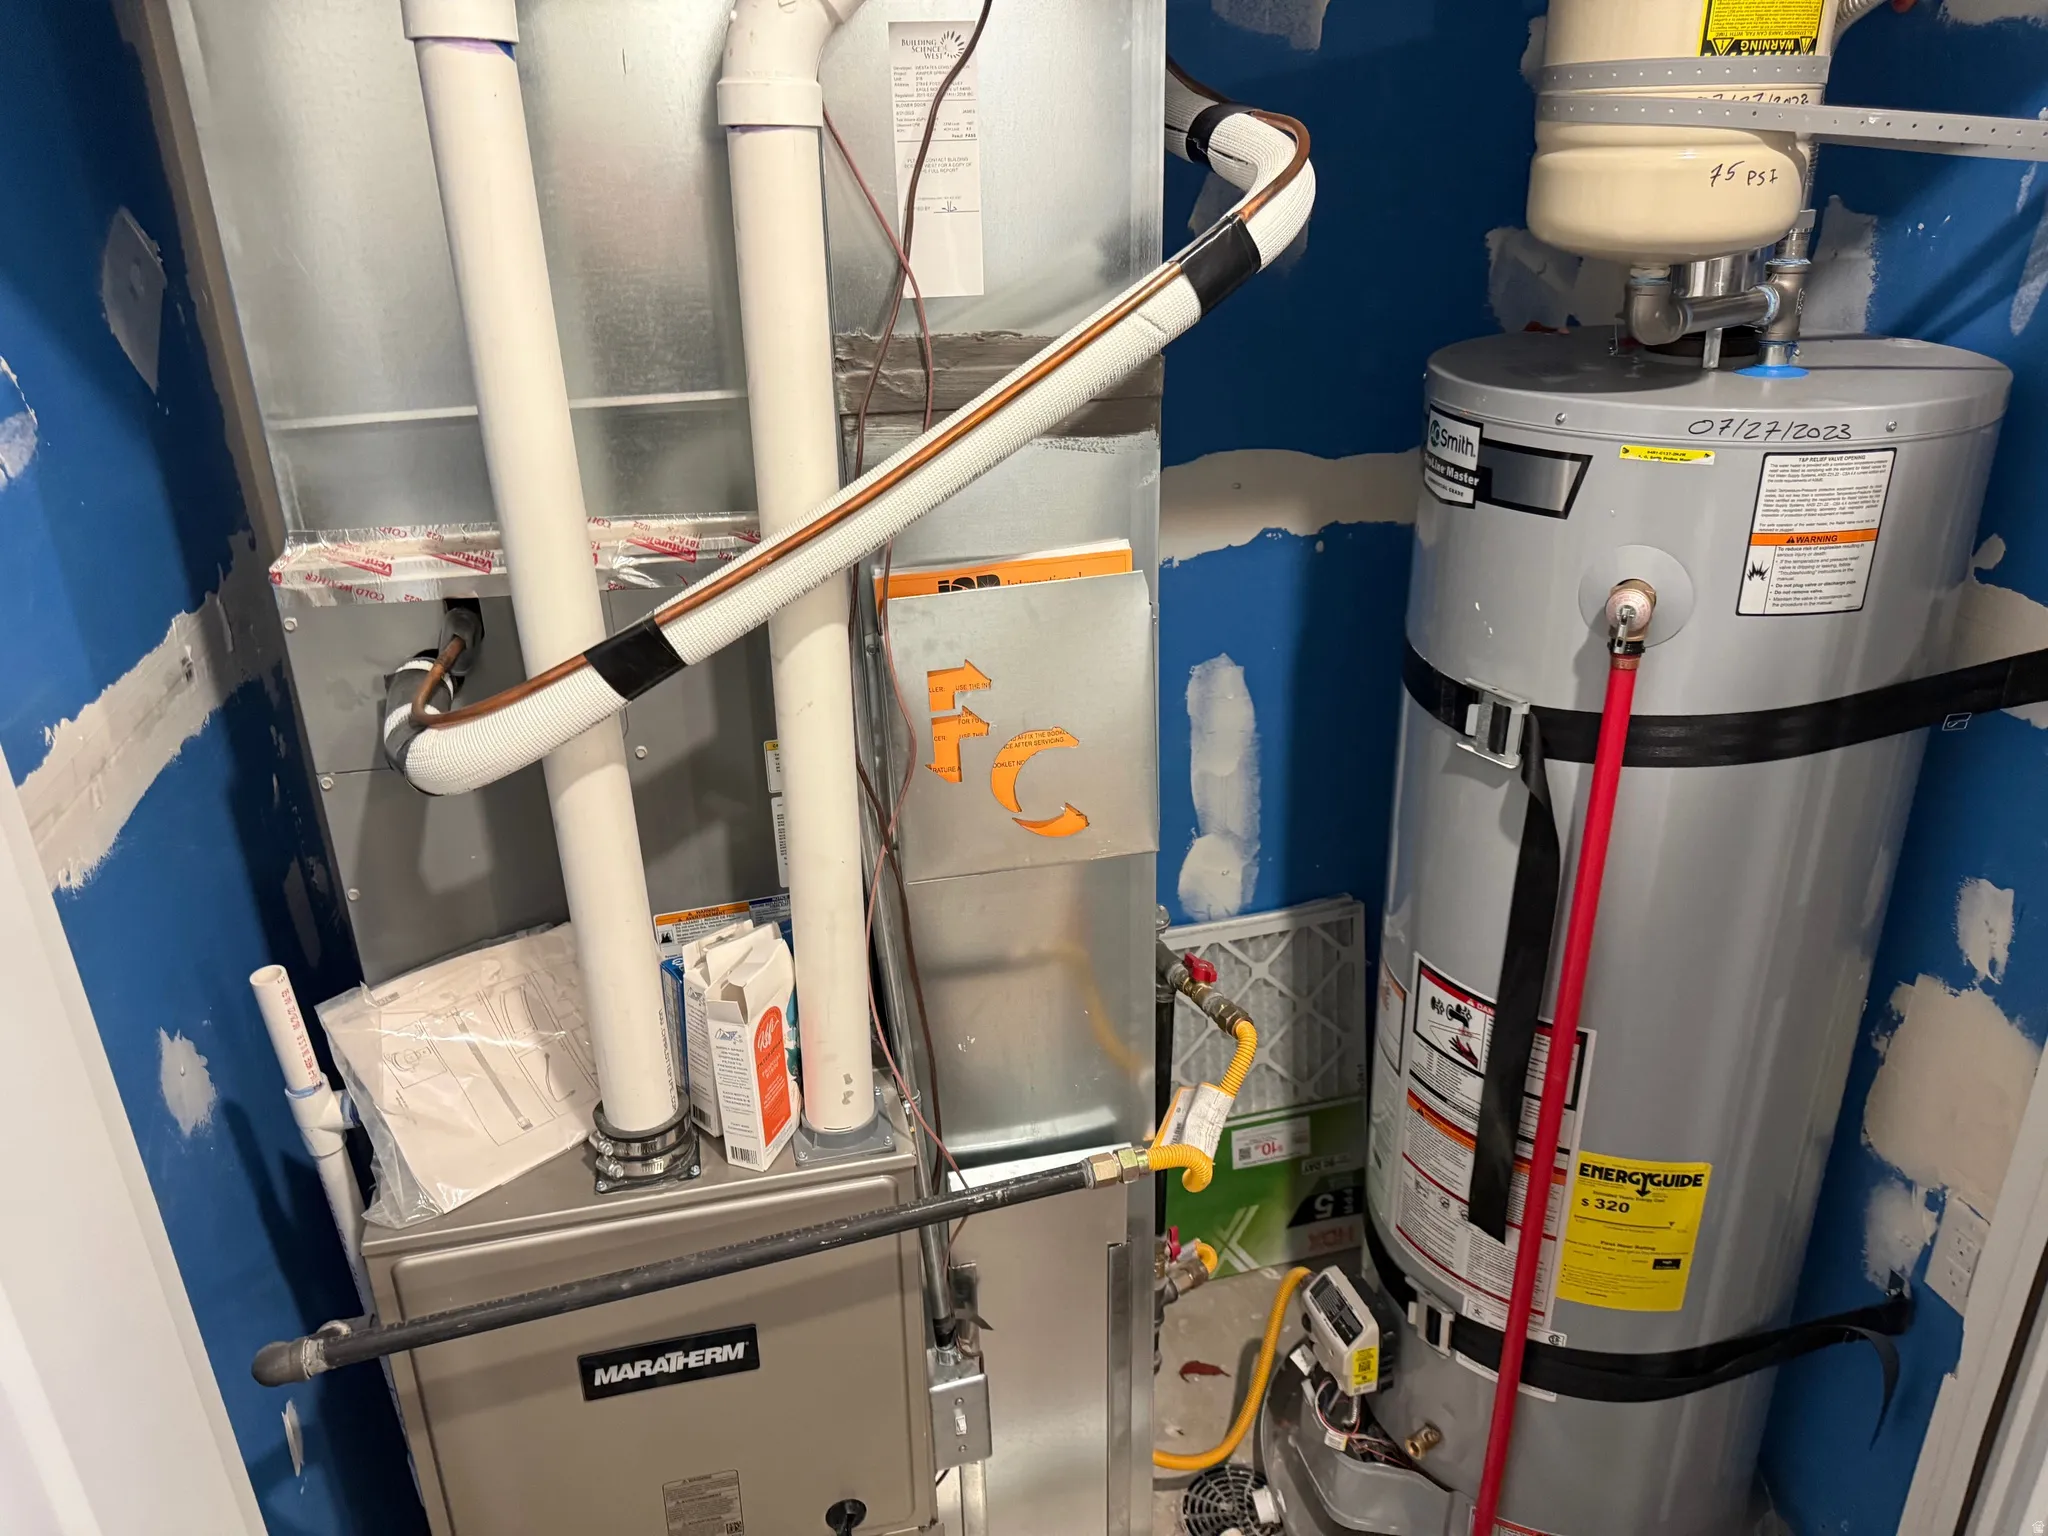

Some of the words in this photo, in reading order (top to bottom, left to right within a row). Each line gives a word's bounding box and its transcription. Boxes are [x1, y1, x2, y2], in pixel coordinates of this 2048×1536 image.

[911, 45, 941, 53] SCIENCE
[1740, 40, 1795, 51] WARNING
[924, 52, 943, 60] WEST
[1747, 168, 1778, 186] PSI
[1688, 418, 1852, 442] 07/27/2023
[1446, 466, 1480, 487] Master
[1796, 535, 1837, 543] WARNING
[355, 589, 385, 602] COLD
[1014, 740, 1033, 748] AFTER
[1033, 737, 1065, 746] SERVICING
[1017, 733, 1033, 741] AFFIX
[992, 761, 1015, 769] OOKLET
[1579, 1162, 1705, 1190] ENERGYGUIDE
[1313, 1193, 1336, 1219] 5
[1594, 1198, 1630, 1214] 320
[593, 1341, 746, 1387] MARATHERM
